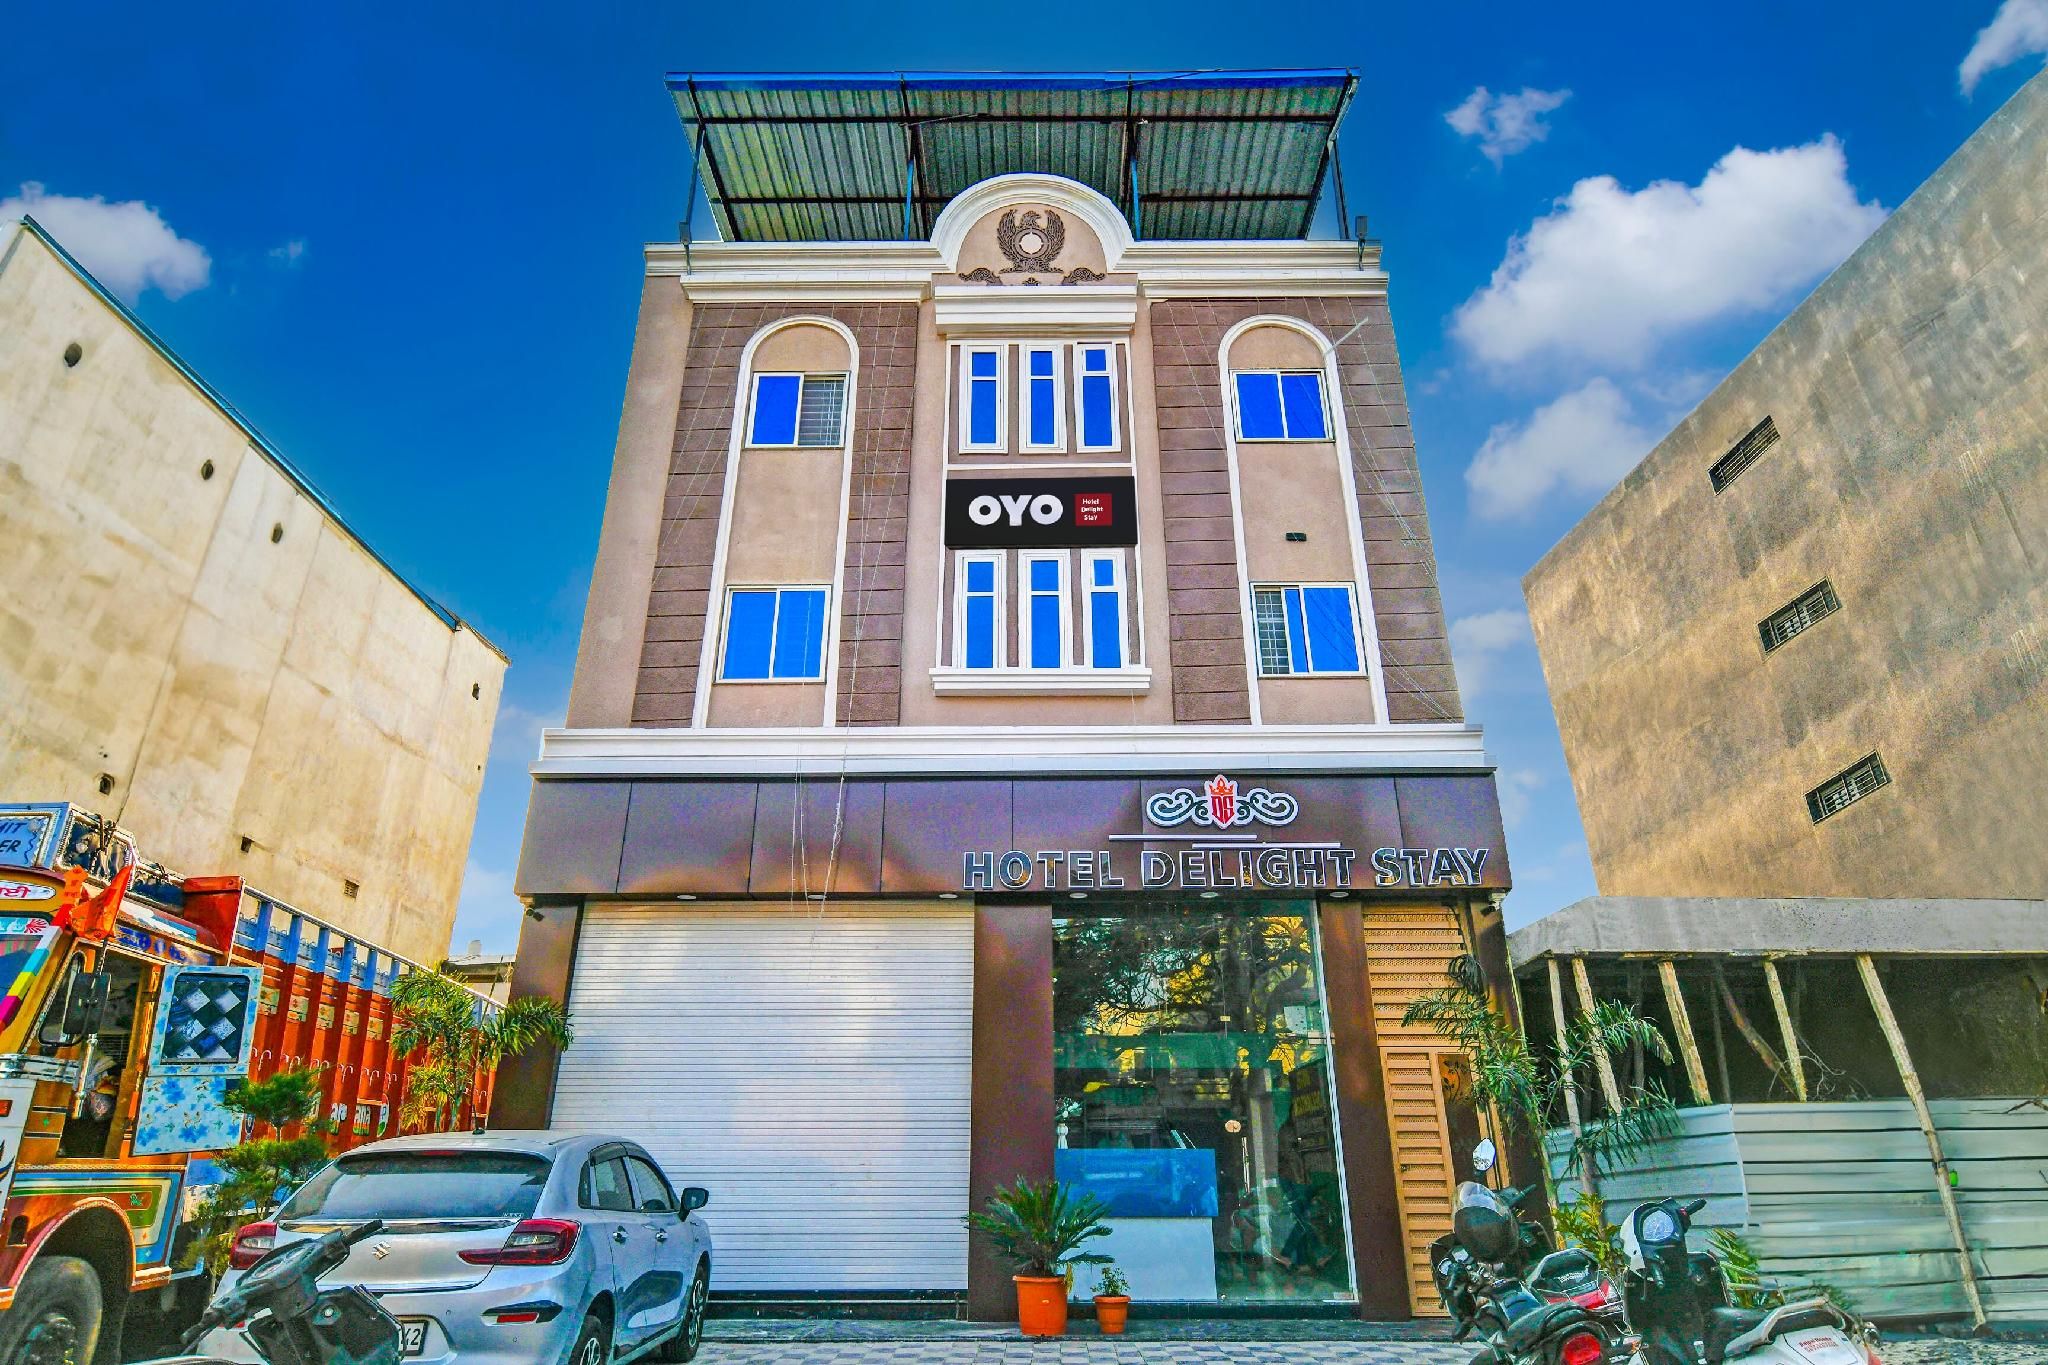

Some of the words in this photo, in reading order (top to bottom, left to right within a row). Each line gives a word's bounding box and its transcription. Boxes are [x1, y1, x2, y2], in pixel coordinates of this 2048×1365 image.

[969, 494, 1063, 526] OYO
[962, 850, 1125, 889] HOTEL
[1140, 848, 1356, 889] DELIGHT
[1370, 847, 1490, 887] STAY
